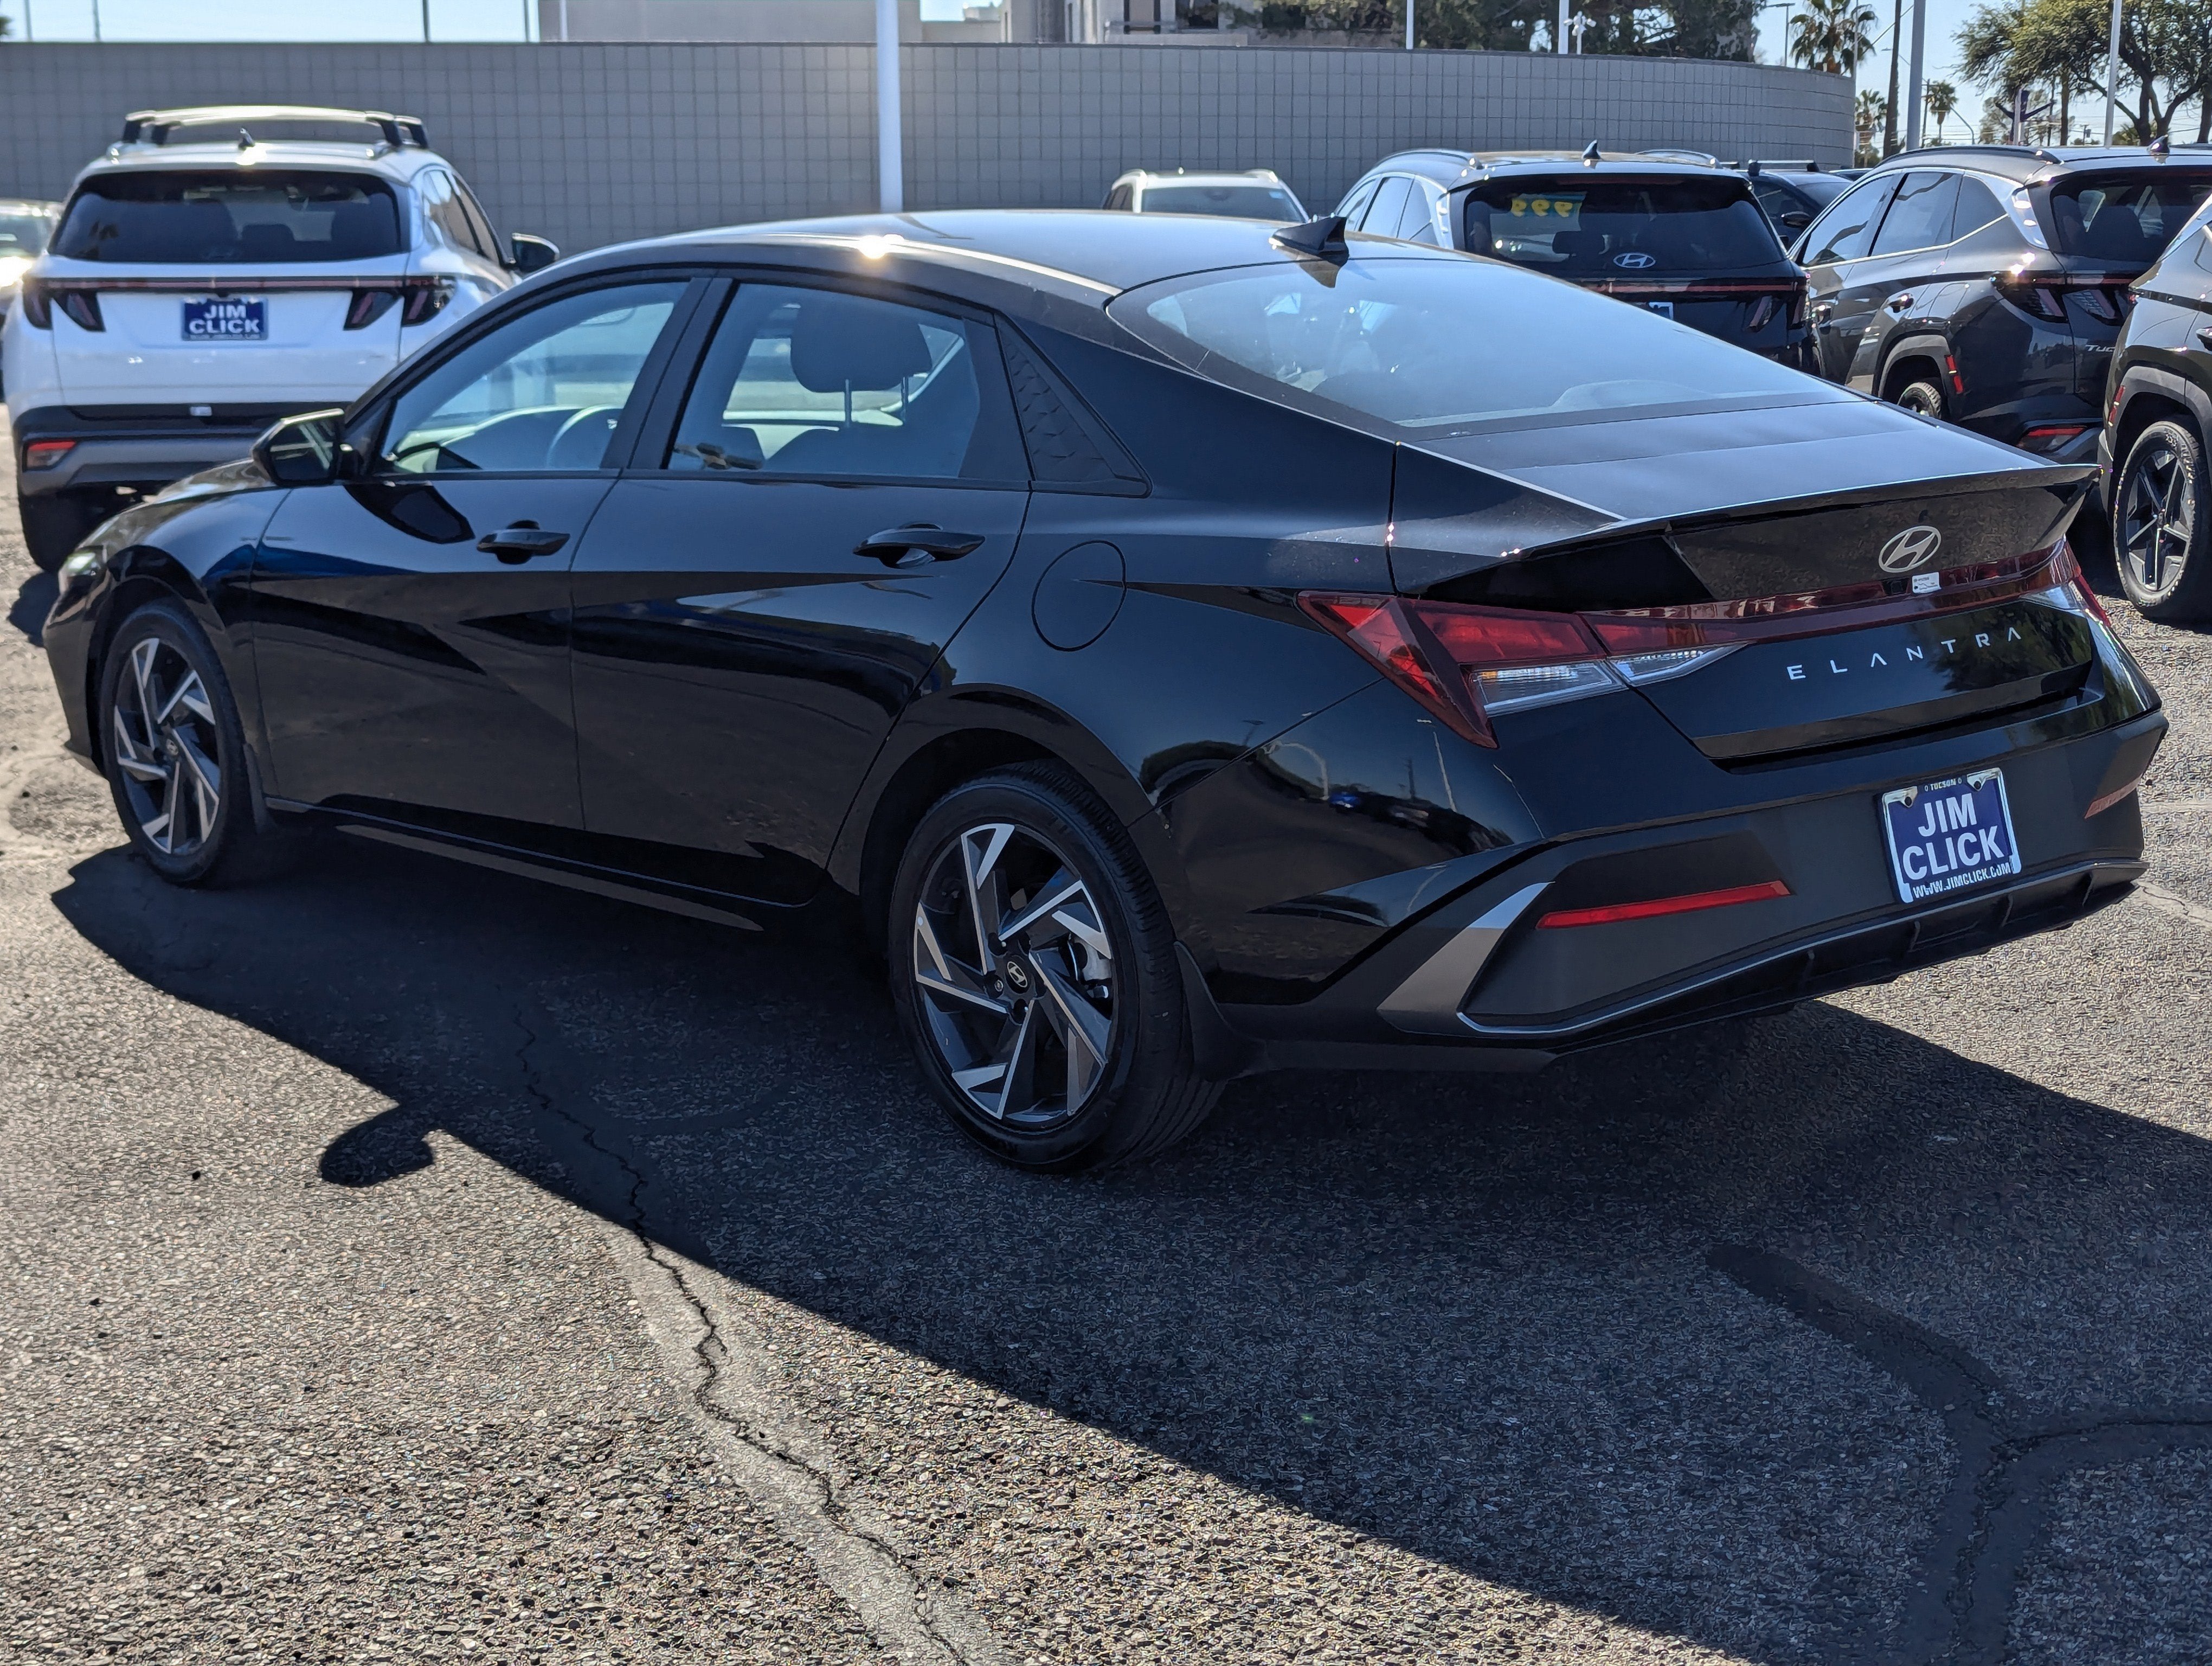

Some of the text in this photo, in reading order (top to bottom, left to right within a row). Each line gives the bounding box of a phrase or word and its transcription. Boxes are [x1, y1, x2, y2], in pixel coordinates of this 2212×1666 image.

[189, 319, 260, 334] CLICK
[204, 304, 247, 319] JIM
[1786, 627, 2022, 680] ELANTRA
[1918, 793, 1977, 837] JIM
[1903, 825, 2004, 880] CLICK
[1913, 862, 2011, 899] WWW.JIMCLICK.COM
